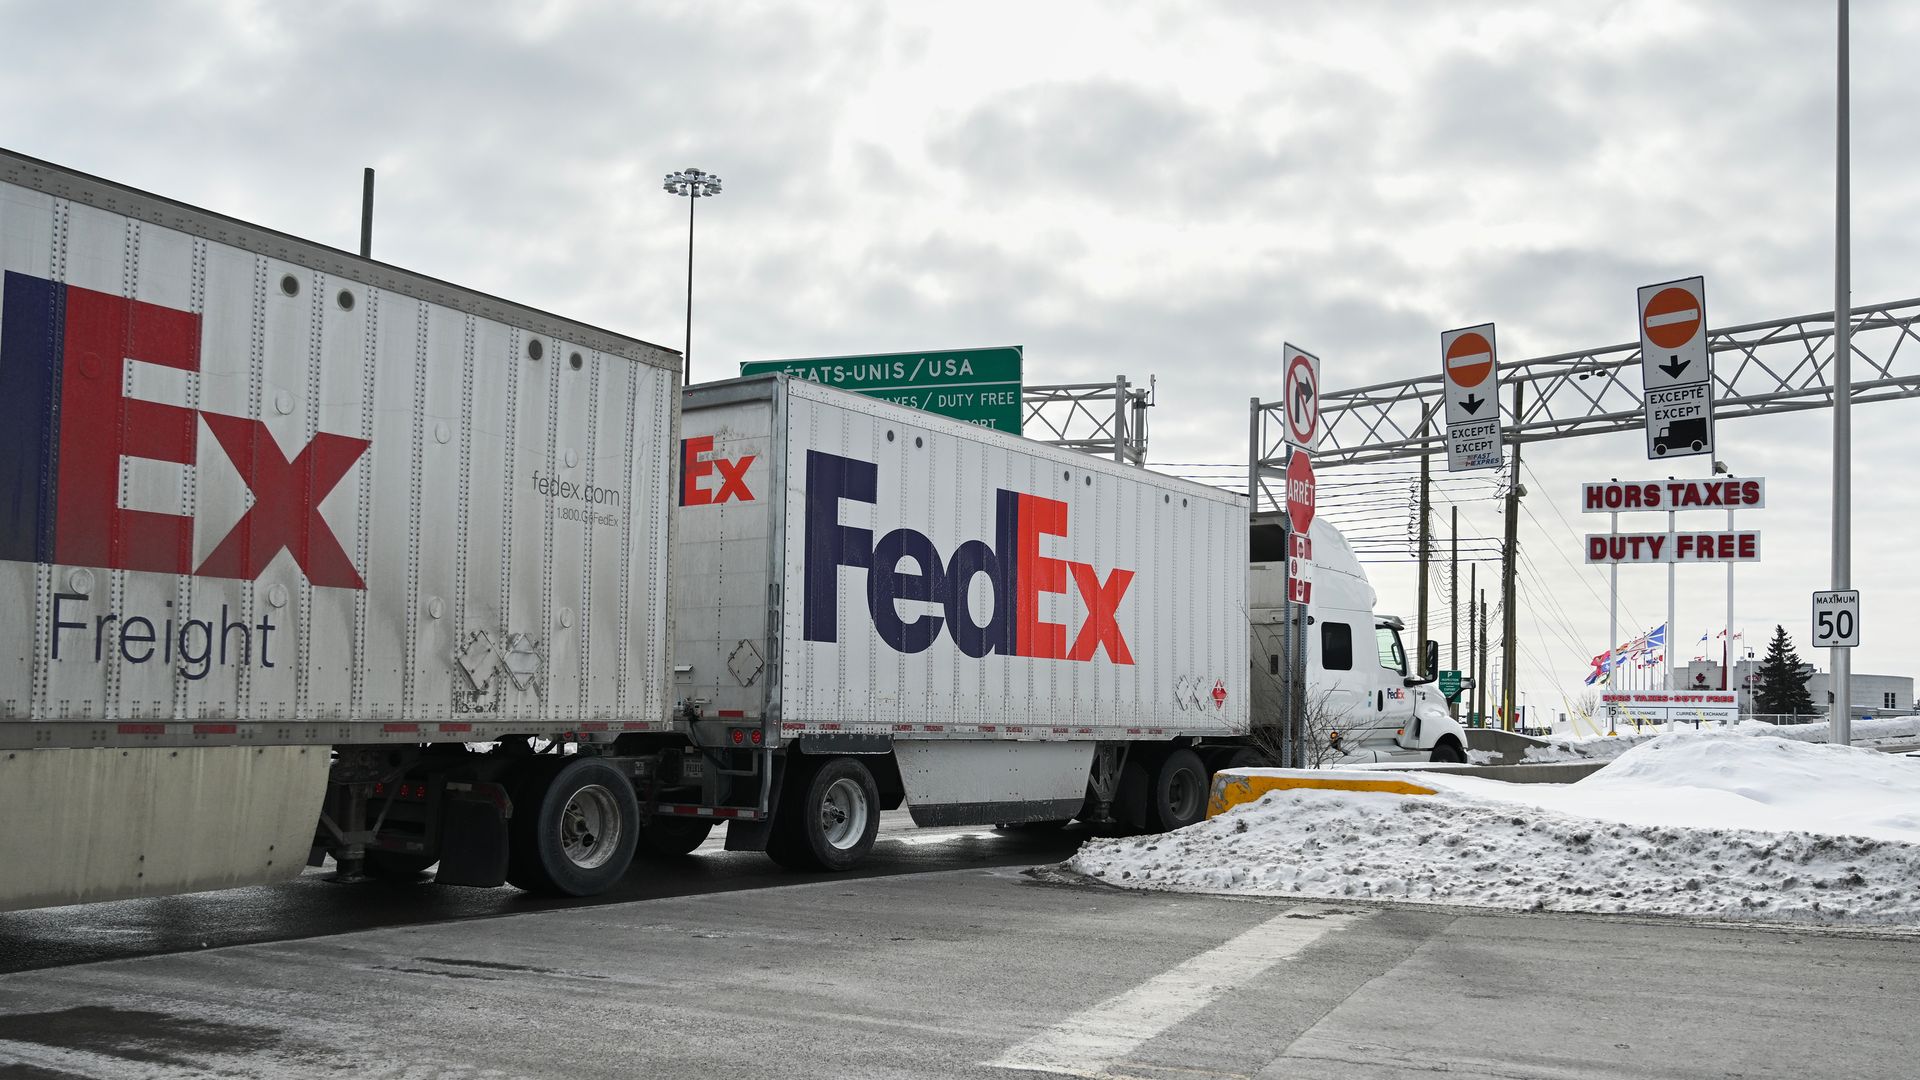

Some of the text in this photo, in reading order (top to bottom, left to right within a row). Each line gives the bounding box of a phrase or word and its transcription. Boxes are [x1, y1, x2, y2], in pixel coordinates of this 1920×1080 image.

[938, 393, 974, 408] DUTY
[980, 391, 1015, 406] FREE
[1650, 386, 1704, 405] EXCEPTÉ
[1655, 405, 1701, 420] EXCEPT
[1451, 423, 1496, 439] EXCEPTÉ
[1455, 440, 1493, 453] EXCEPT
[1473, 452, 1491, 460] FAST
[679, 435, 756, 507] Ex
[532, 470, 620, 507] fedex.com
[1287, 479, 1314, 507] ARRÊT
[1586, 481, 1760, 509] HORS TAXES
[557, 507, 619, 527] 1.800.GoFedEx
[1589, 534, 1755, 560] DUTY FREE
[803, 449, 1136, 666] FedEx
[1816, 596, 1855, 604] MAXIMUM
[1818, 610, 1853, 639] 50
[52, 593, 276, 680] Freight
[1387, 687, 1405, 700] FedEx
[1602, 694, 1631, 702] HORS
[1608, 706, 1617, 716] 15
